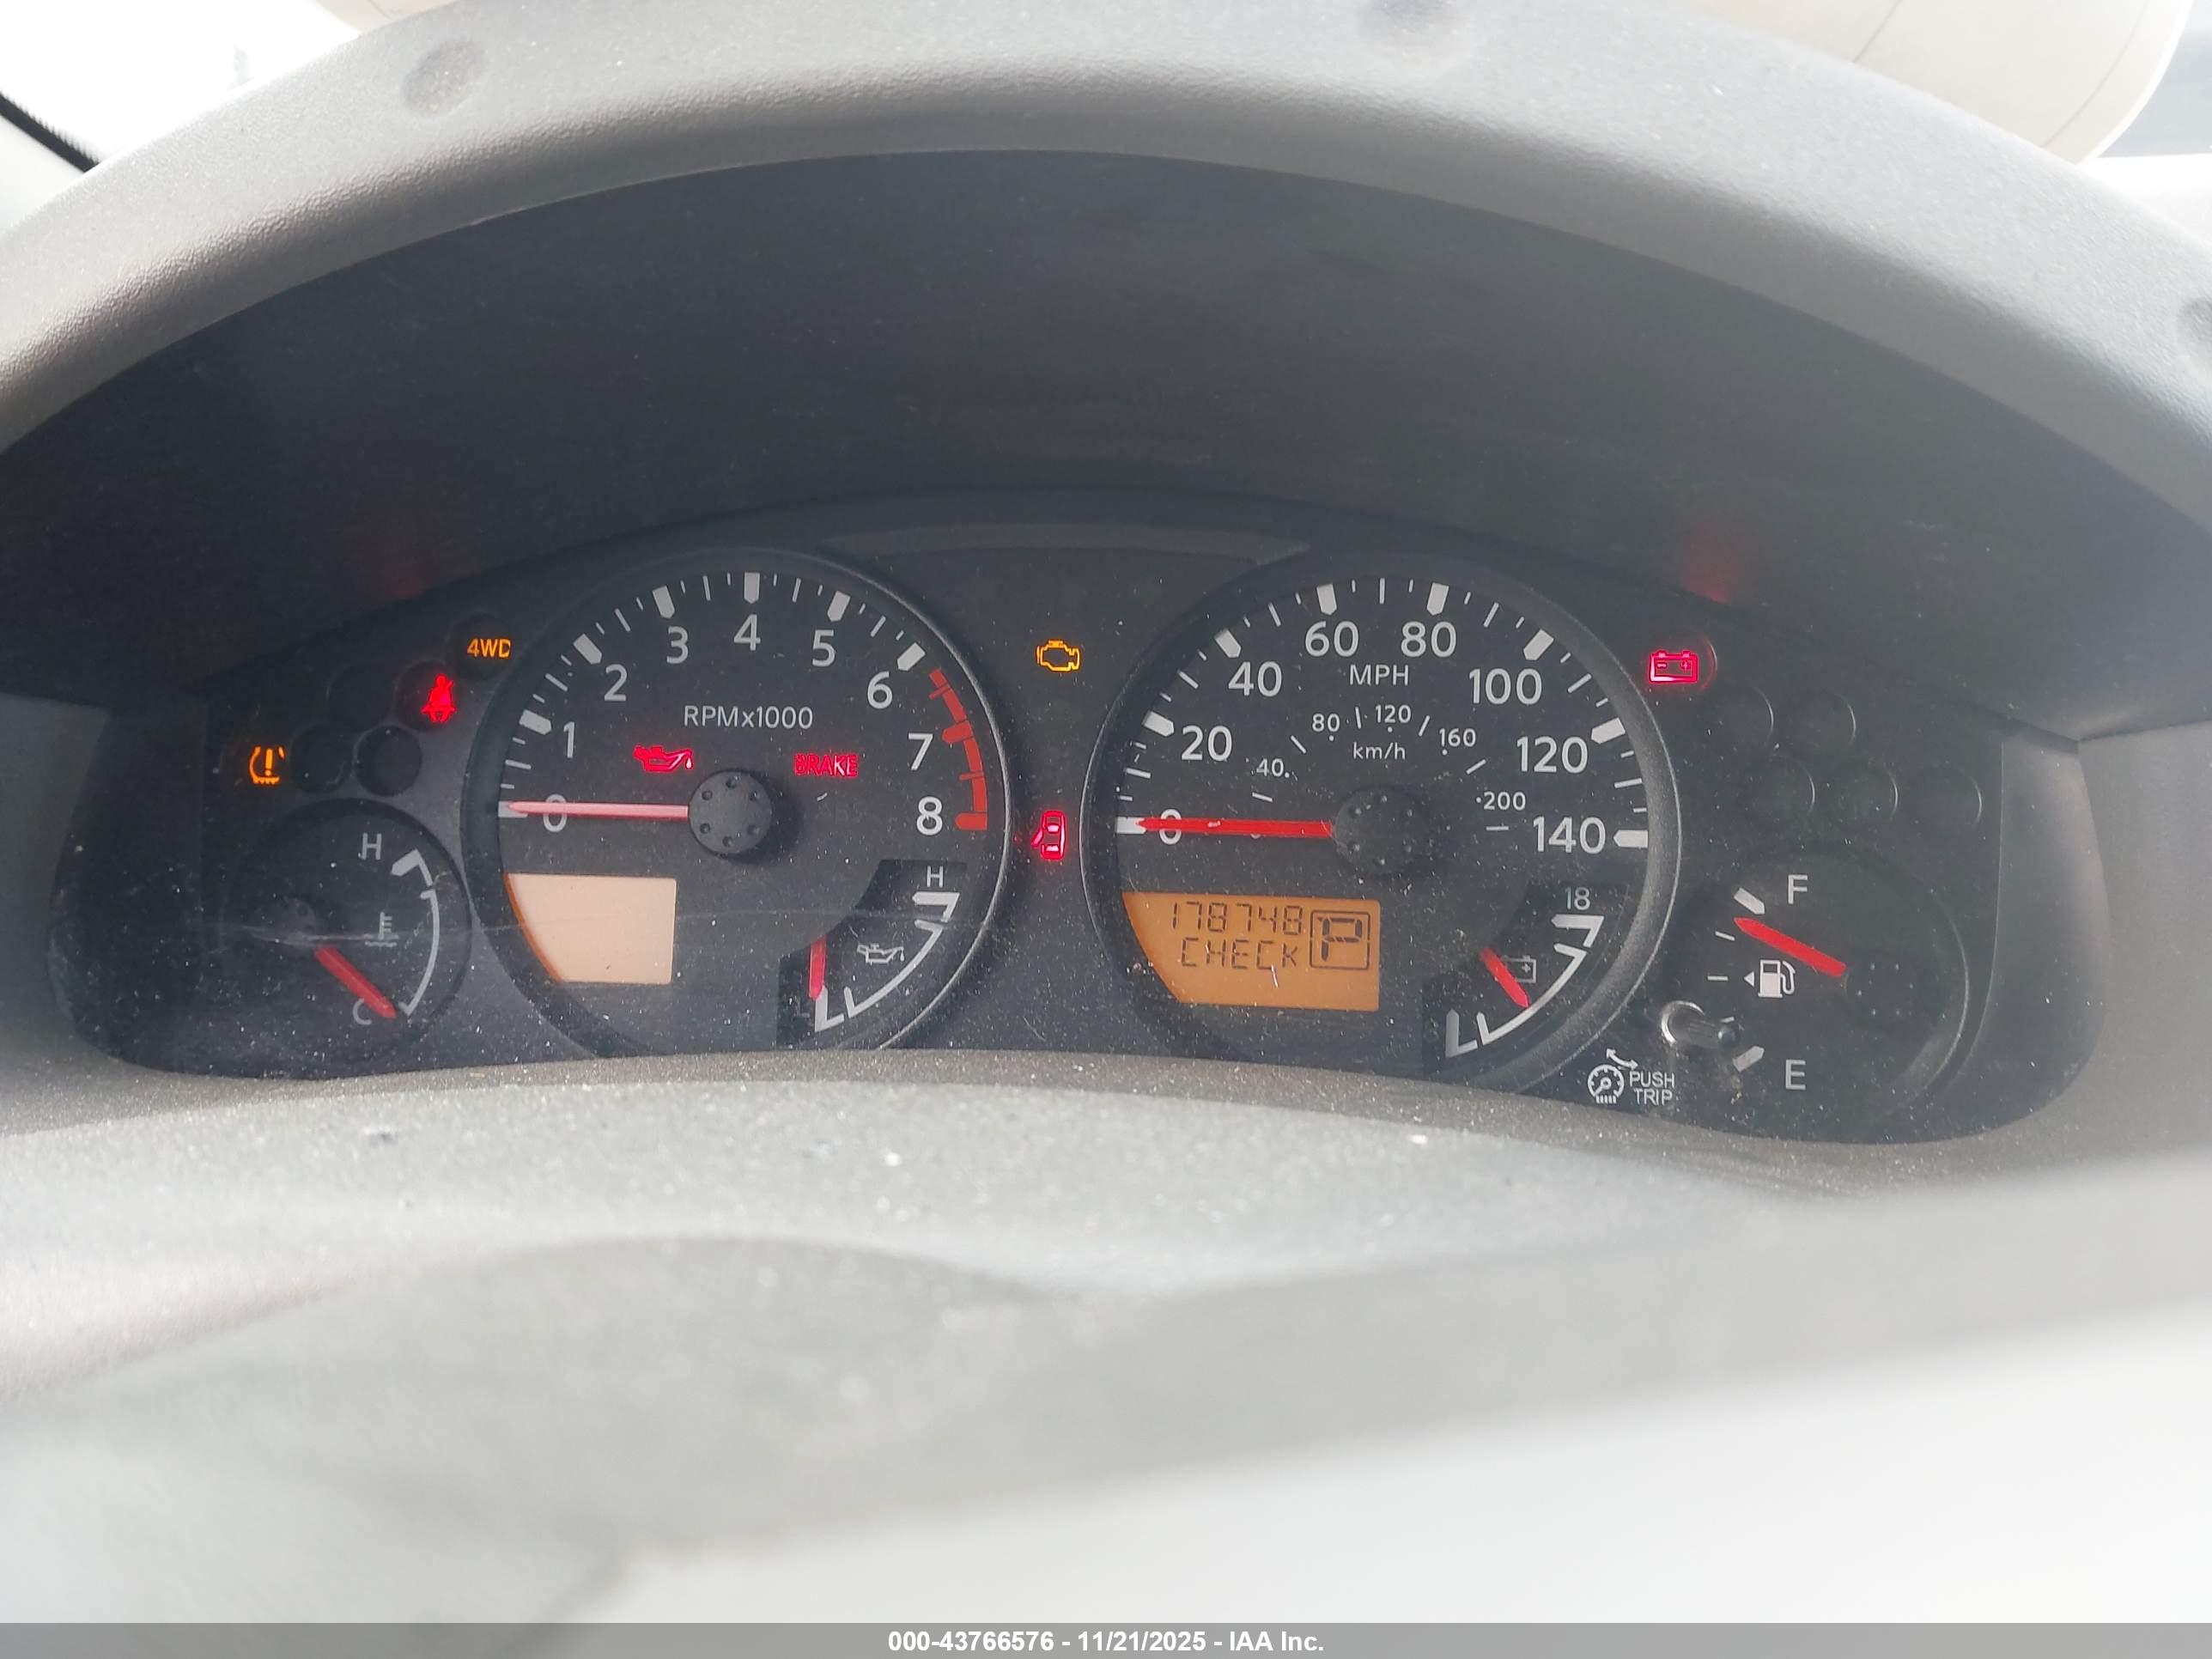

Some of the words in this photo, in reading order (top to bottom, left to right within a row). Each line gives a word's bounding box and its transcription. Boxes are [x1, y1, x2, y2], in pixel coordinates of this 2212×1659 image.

[666, 627, 689, 663] 3
[734, 614, 760, 651] 4
[812, 630, 836, 665] 5
[1305, 622, 1358, 657] 60
[1401, 622, 1456, 657] 80
[467, 638, 511, 659] 4WD
[605, 665, 627, 701] 2
[867, 672, 892, 708] 6
[1229, 661, 1281, 696] 40
[1349, 665, 1409, 686] MPH
[1469, 668, 1542, 704] 100
[684, 706, 813, 729] RPMx1000
[1312, 714, 1340, 732] 80
[1374, 705, 1411, 724] 120
[564, 722, 574, 757] 1
[908, 734, 933, 769] 7
[1182, 726, 1231, 760] 20
[1352, 743, 1406, 759] km/h
[1439, 729, 1476, 748] 160
[794, 754, 857, 776] BRAKE
[1256, 758, 1283, 776] 40
[1517, 737, 1588, 772] 120
[544, 795, 568, 832] 0
[917, 797, 943, 835] 8
[1483, 793, 1526, 810] 200
[362, 834, 381, 859] H
[1533, 817, 1605, 853] 140
[927, 866, 944, 887] H
[1788, 875, 1808, 903] F
[1565, 888, 1590, 908] 18
[1172, 902, 1303, 934] 178748
[1182, 938, 1298, 969] CHECK
[1318, 917, 1363, 962] P
[353, 999, 372, 1025] C
[1630, 1071, 1675, 1088] PUSH
[1786, 1060, 1806, 1090] E
[1633, 1088, 1673, 1106] TRIP
